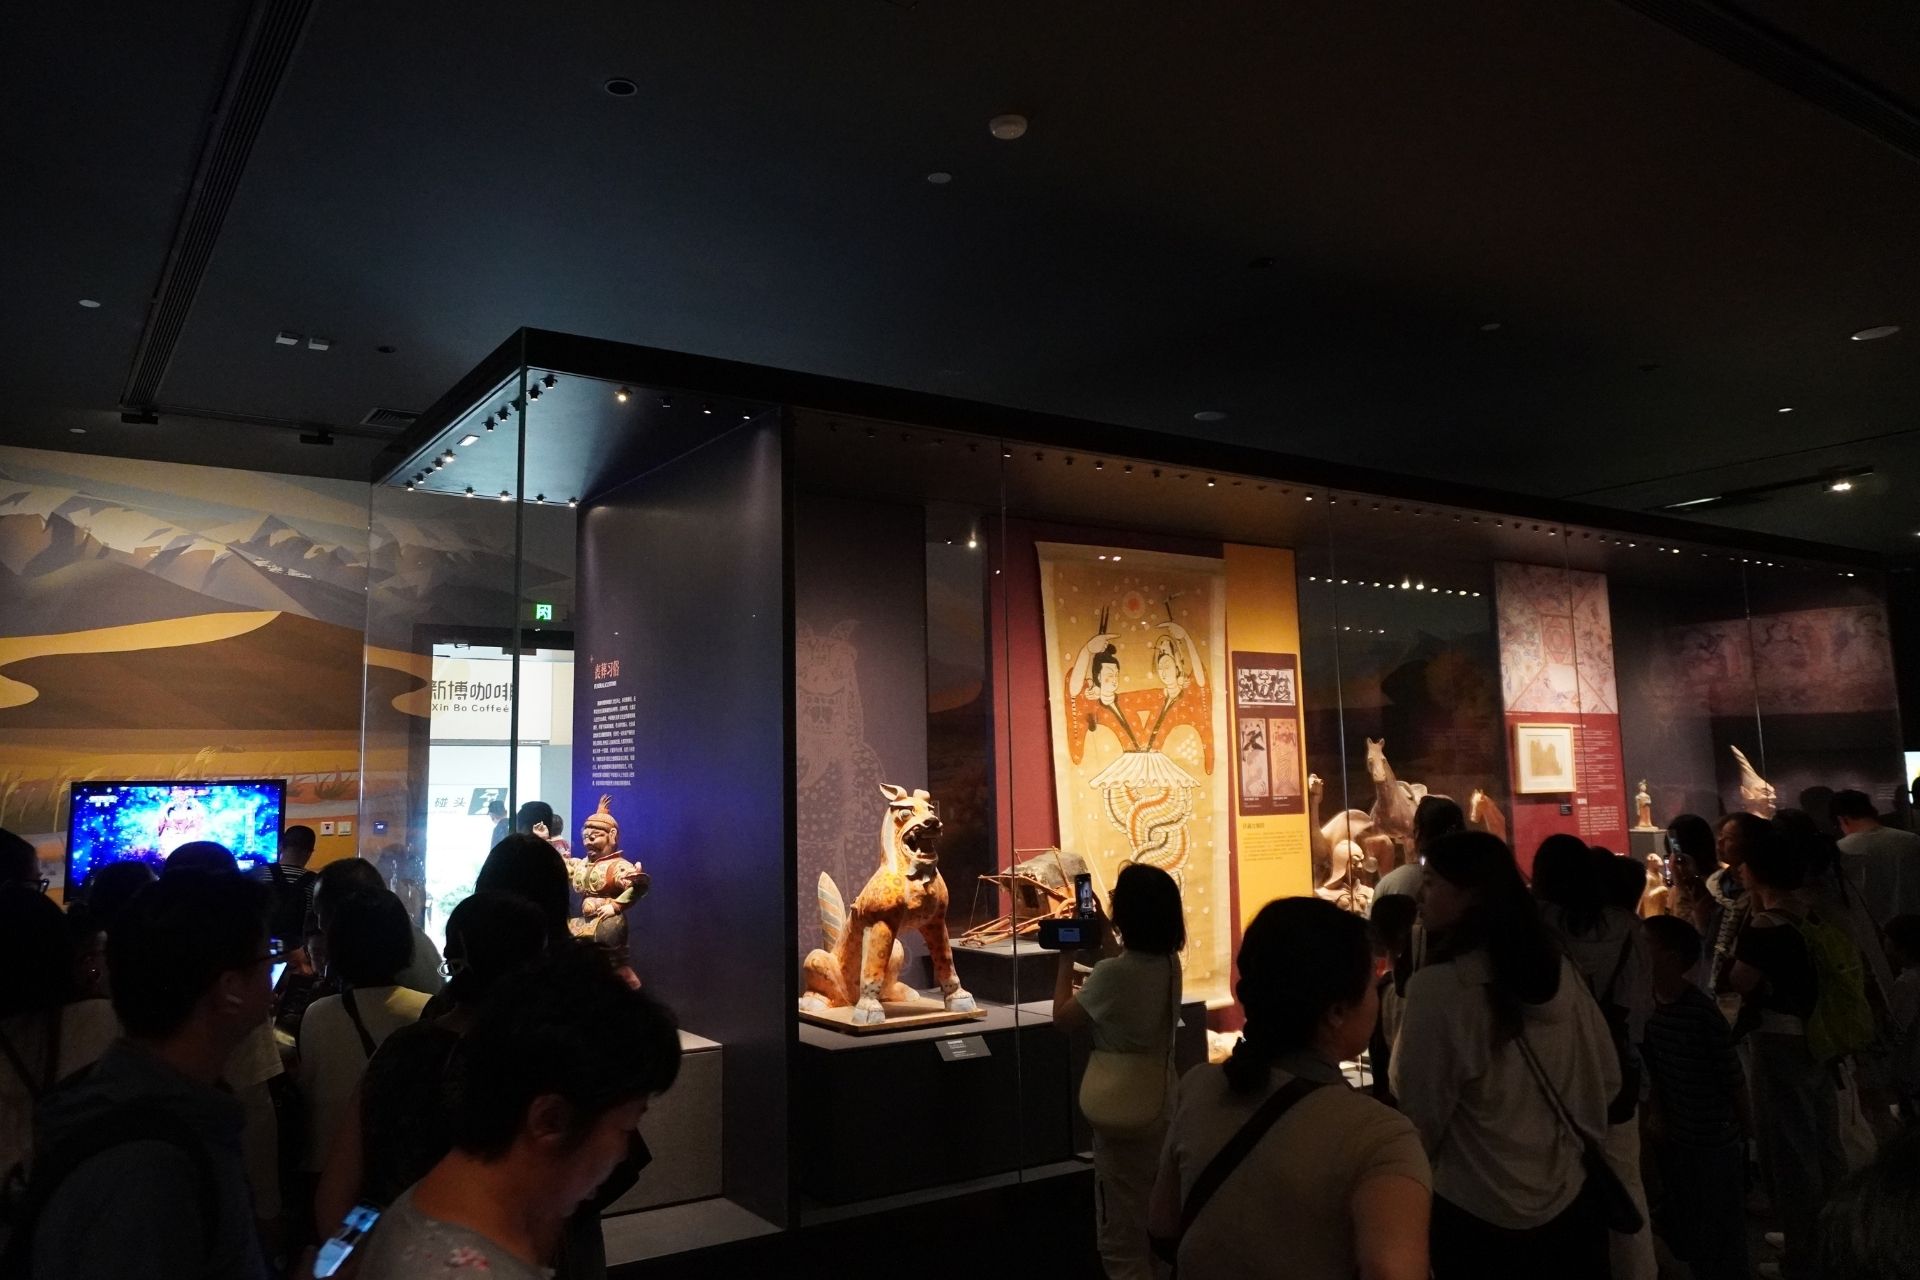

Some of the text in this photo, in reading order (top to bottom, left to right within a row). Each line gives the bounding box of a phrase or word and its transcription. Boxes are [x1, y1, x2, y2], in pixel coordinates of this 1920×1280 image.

[432, 680, 513, 700] 新博咖啡
[431, 704, 449, 712] Xin
[453, 703, 468, 712] Bo
[434, 797, 466, 807] 碰头
